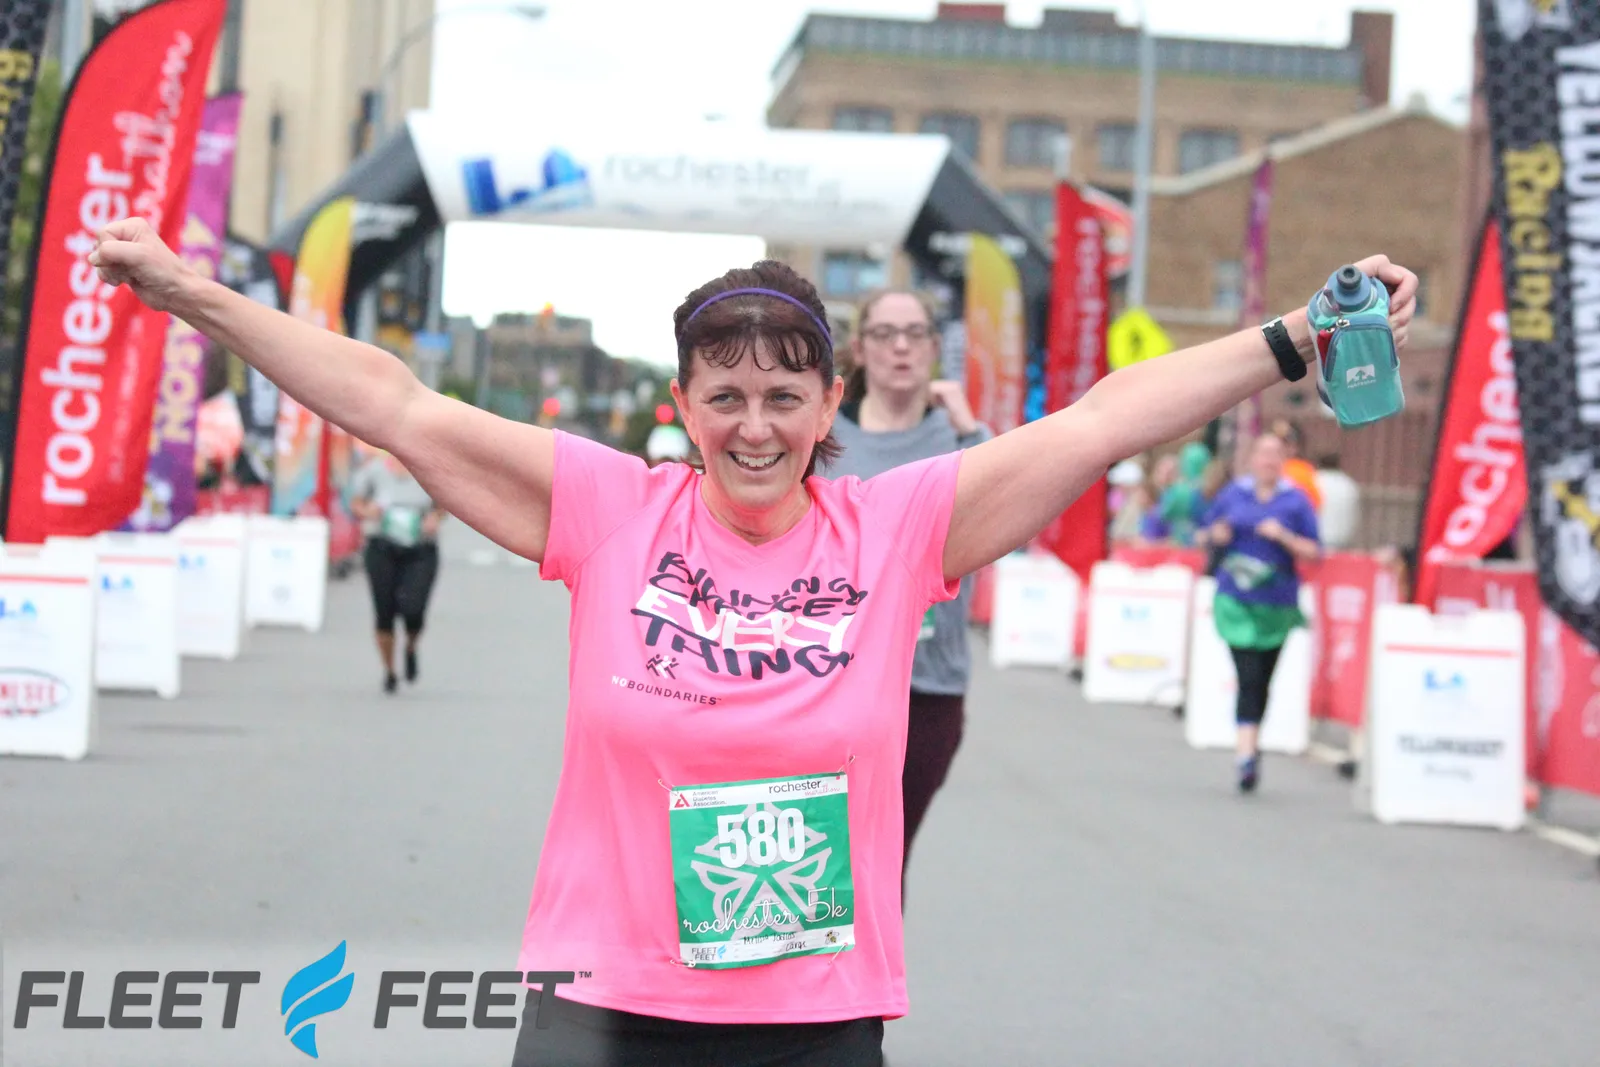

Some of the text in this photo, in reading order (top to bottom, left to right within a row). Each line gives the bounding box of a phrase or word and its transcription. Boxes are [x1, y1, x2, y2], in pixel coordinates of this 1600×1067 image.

[630, 608, 855, 680] THING
[636, 584, 856, 653] EVERY
[769, 779, 822, 794] rochester
[717, 808, 806, 869] 580
[683, 887, 848, 935] rochester 5k
